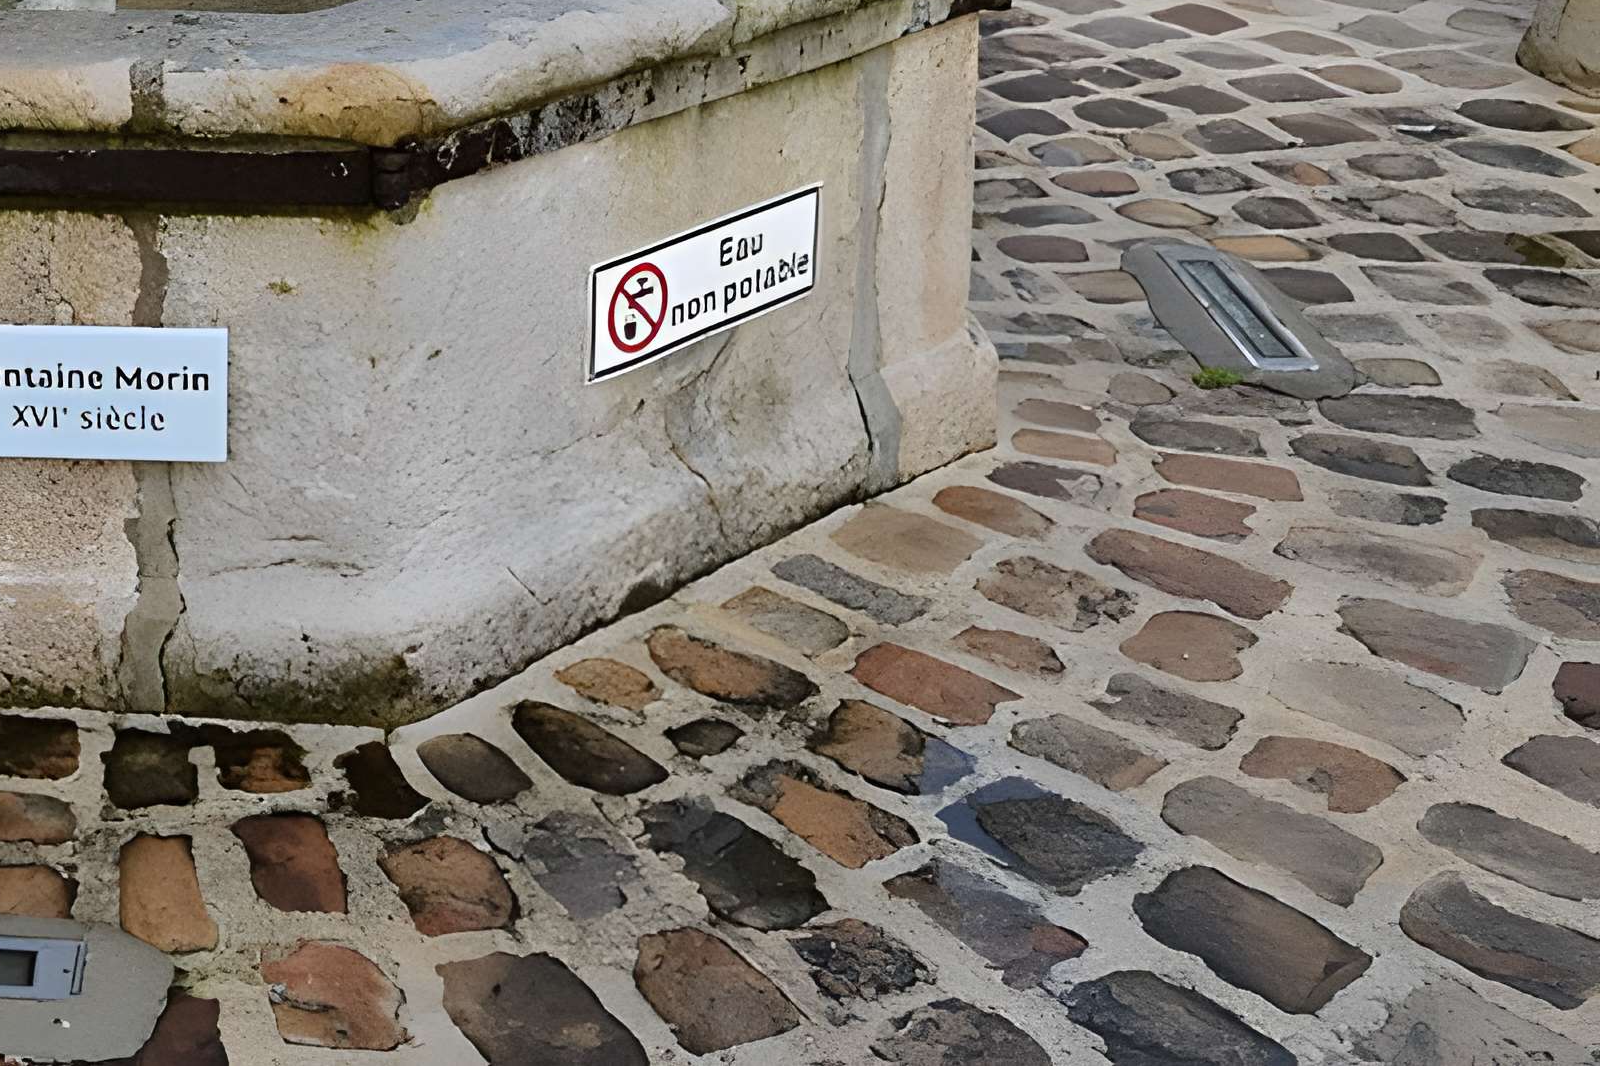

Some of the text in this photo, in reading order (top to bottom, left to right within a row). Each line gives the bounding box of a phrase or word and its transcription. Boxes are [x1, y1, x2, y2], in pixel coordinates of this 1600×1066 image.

[719, 233, 763, 267] Eau
[671, 251, 810, 327] non potable
[115, 365, 210, 391] Morin
[80, 405, 166, 432] siècle
